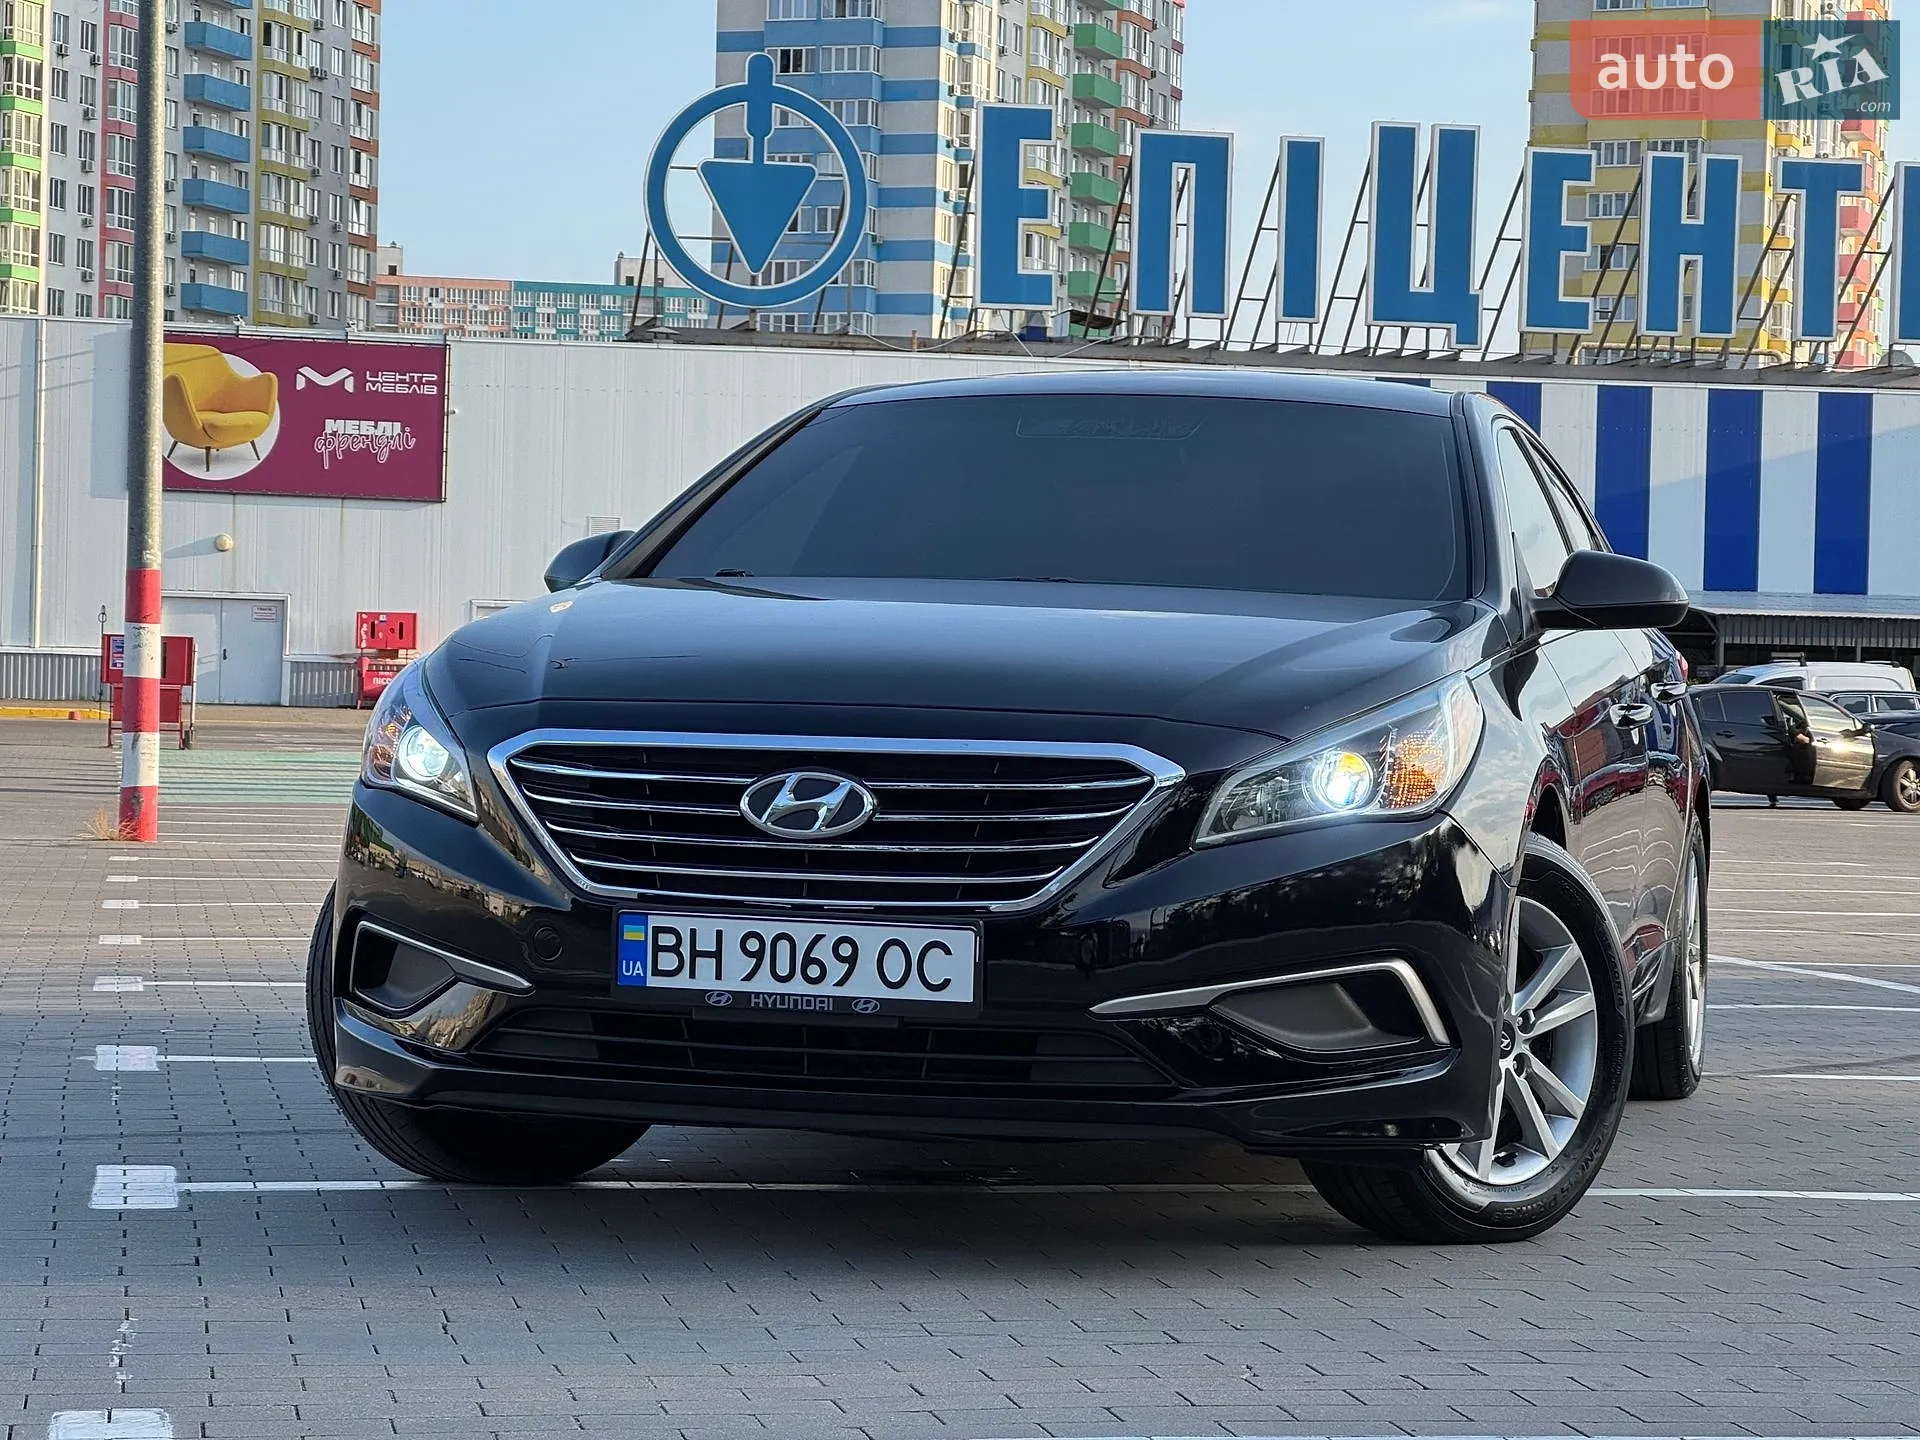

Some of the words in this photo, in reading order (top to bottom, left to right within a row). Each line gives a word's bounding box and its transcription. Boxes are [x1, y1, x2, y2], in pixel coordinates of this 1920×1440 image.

[974, 102, 1920, 350] ЕПІЦЕНТ
[366, 371, 438, 383] ЦЕНТР
[366, 383, 438, 395] МЕБЛІВ
[325, 419, 401, 436] МЕБЛІ
[650, 926, 723, 981] BH
[739, 931, 859, 987] 9069
[876, 938, 953, 993] OC
[622, 961, 645, 977] UA
[750, 994, 833, 1011] HYUNDAI
